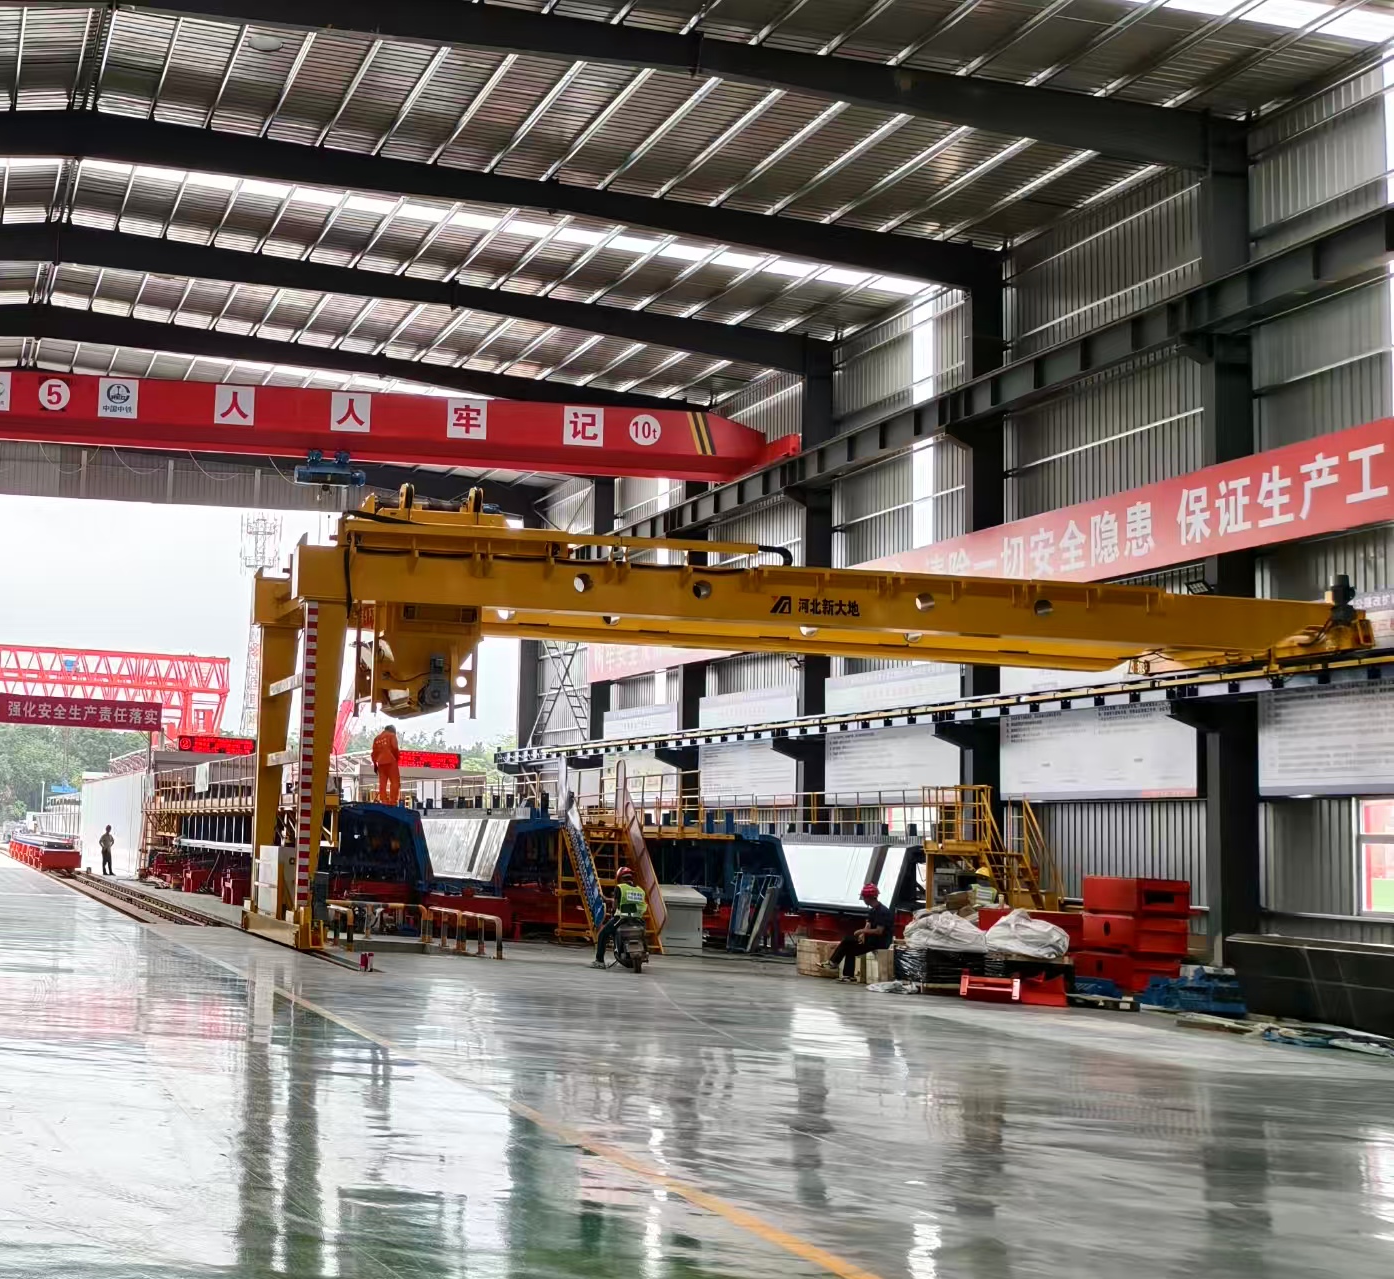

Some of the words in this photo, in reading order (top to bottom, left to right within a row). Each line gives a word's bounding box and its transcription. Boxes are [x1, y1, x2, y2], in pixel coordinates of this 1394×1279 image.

[47, 384, 62, 405] 5
[632, 420, 657, 440] 10t
[1176, 443, 1389, 546] 保证生产工
[798, 598, 861, 617] 河北新大地
[8, 700, 158, 725] 强化安全生产责任落实
